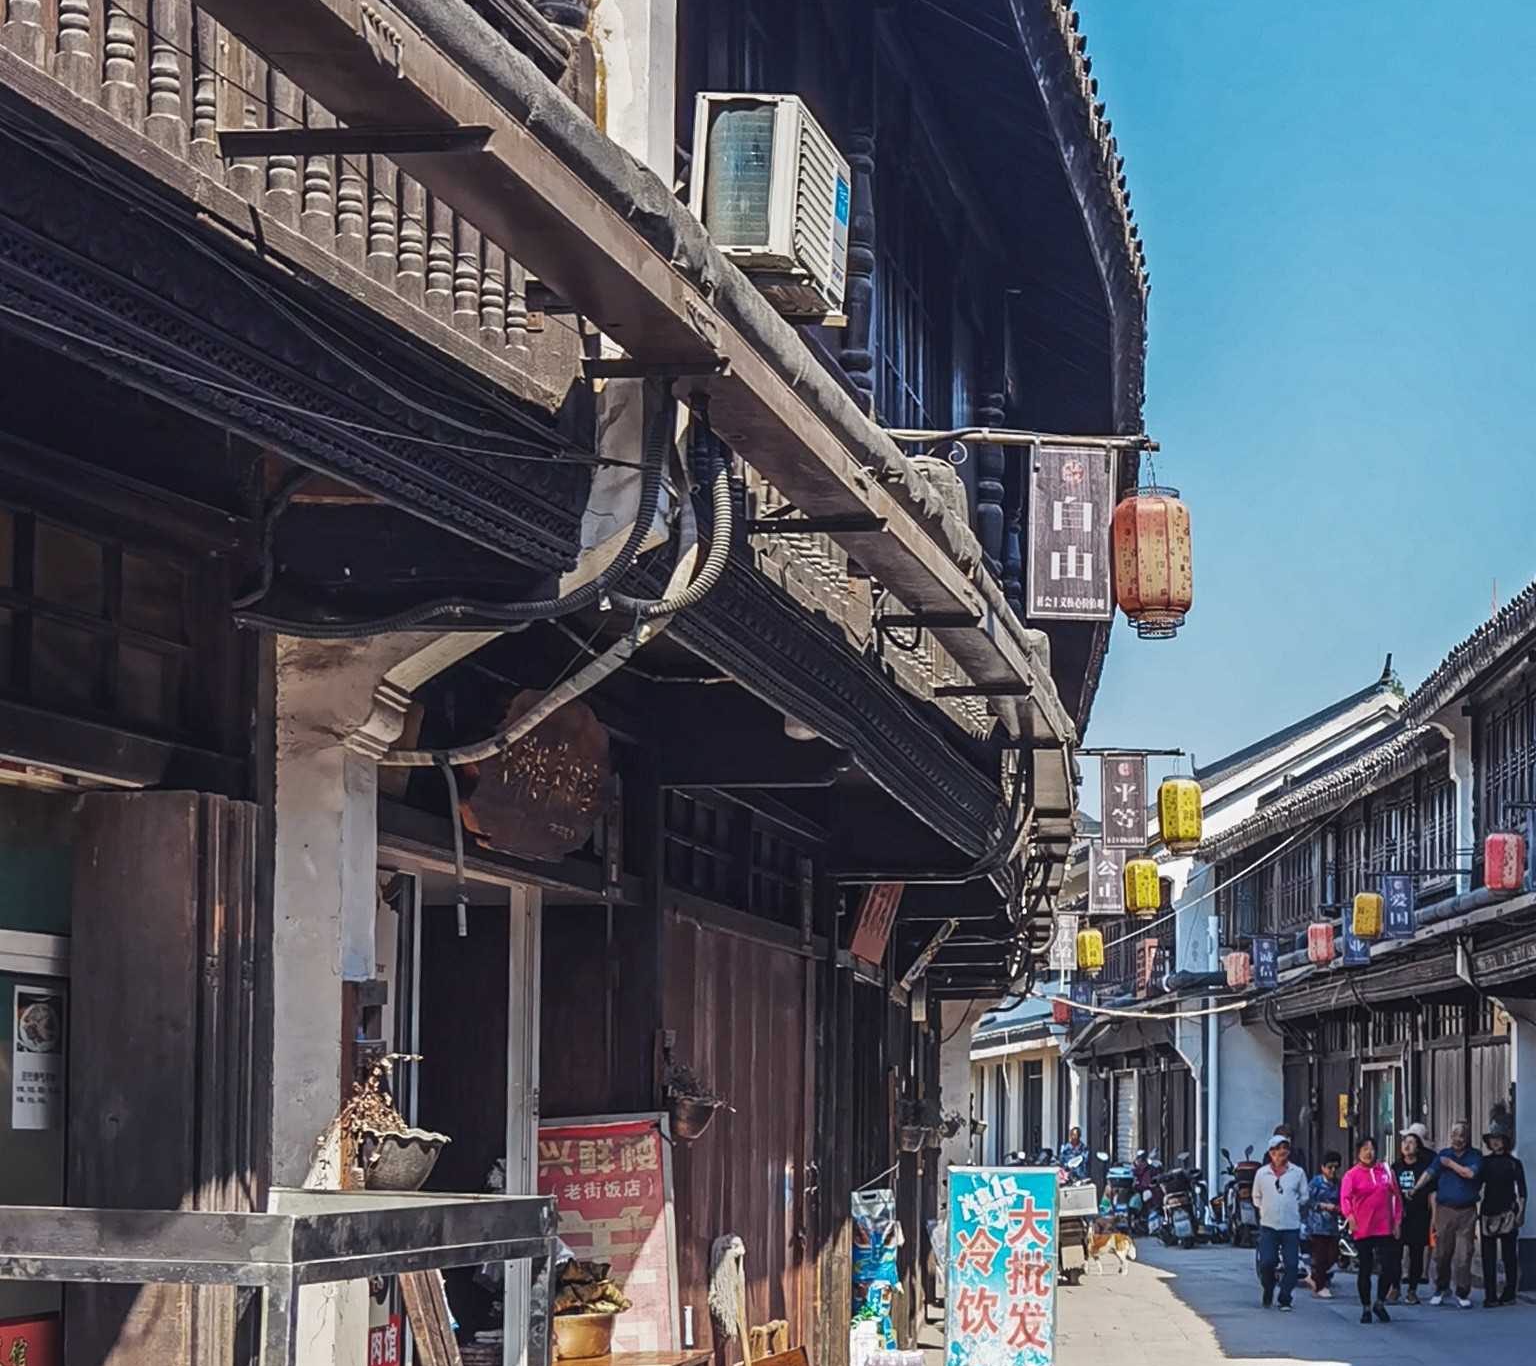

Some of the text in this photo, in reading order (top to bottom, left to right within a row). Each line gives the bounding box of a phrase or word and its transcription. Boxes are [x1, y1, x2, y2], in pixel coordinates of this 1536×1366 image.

[1051, 496, 1093, 581] 自由
[1112, 783, 1139, 829] 平等
[956, 1227, 1001, 1336] 冷饮
[1006, 1196, 1052, 1349] 大批发
